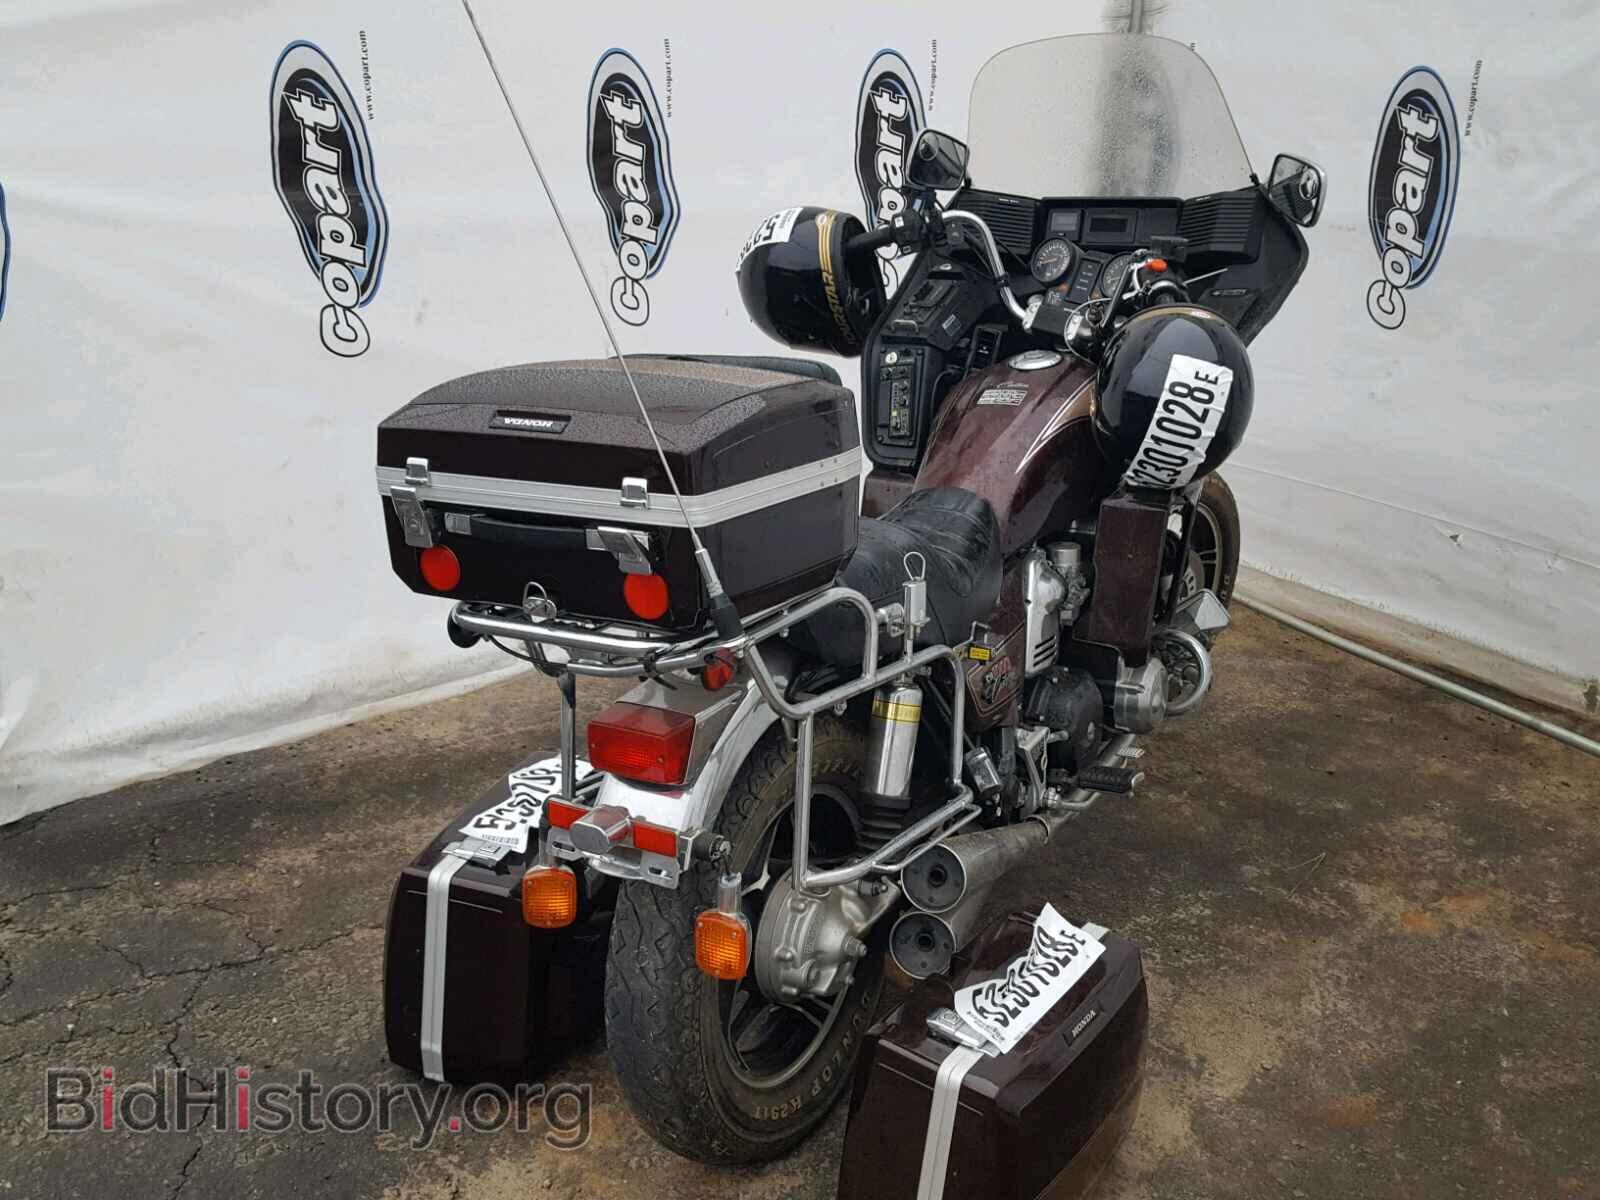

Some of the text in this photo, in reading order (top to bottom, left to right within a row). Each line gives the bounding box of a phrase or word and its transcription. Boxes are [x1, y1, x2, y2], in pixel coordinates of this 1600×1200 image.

[359, 30, 374, 120] www.copart.com
[663, 38, 673, 118] www.copart.com
[282, 88, 371, 358] Copart
[600, 90, 658, 326] Copart
[1367, 104, 1438, 329] Copart
[504, 417, 554, 427] HONDA
[1070, 1009, 1097, 1038] HONDA
